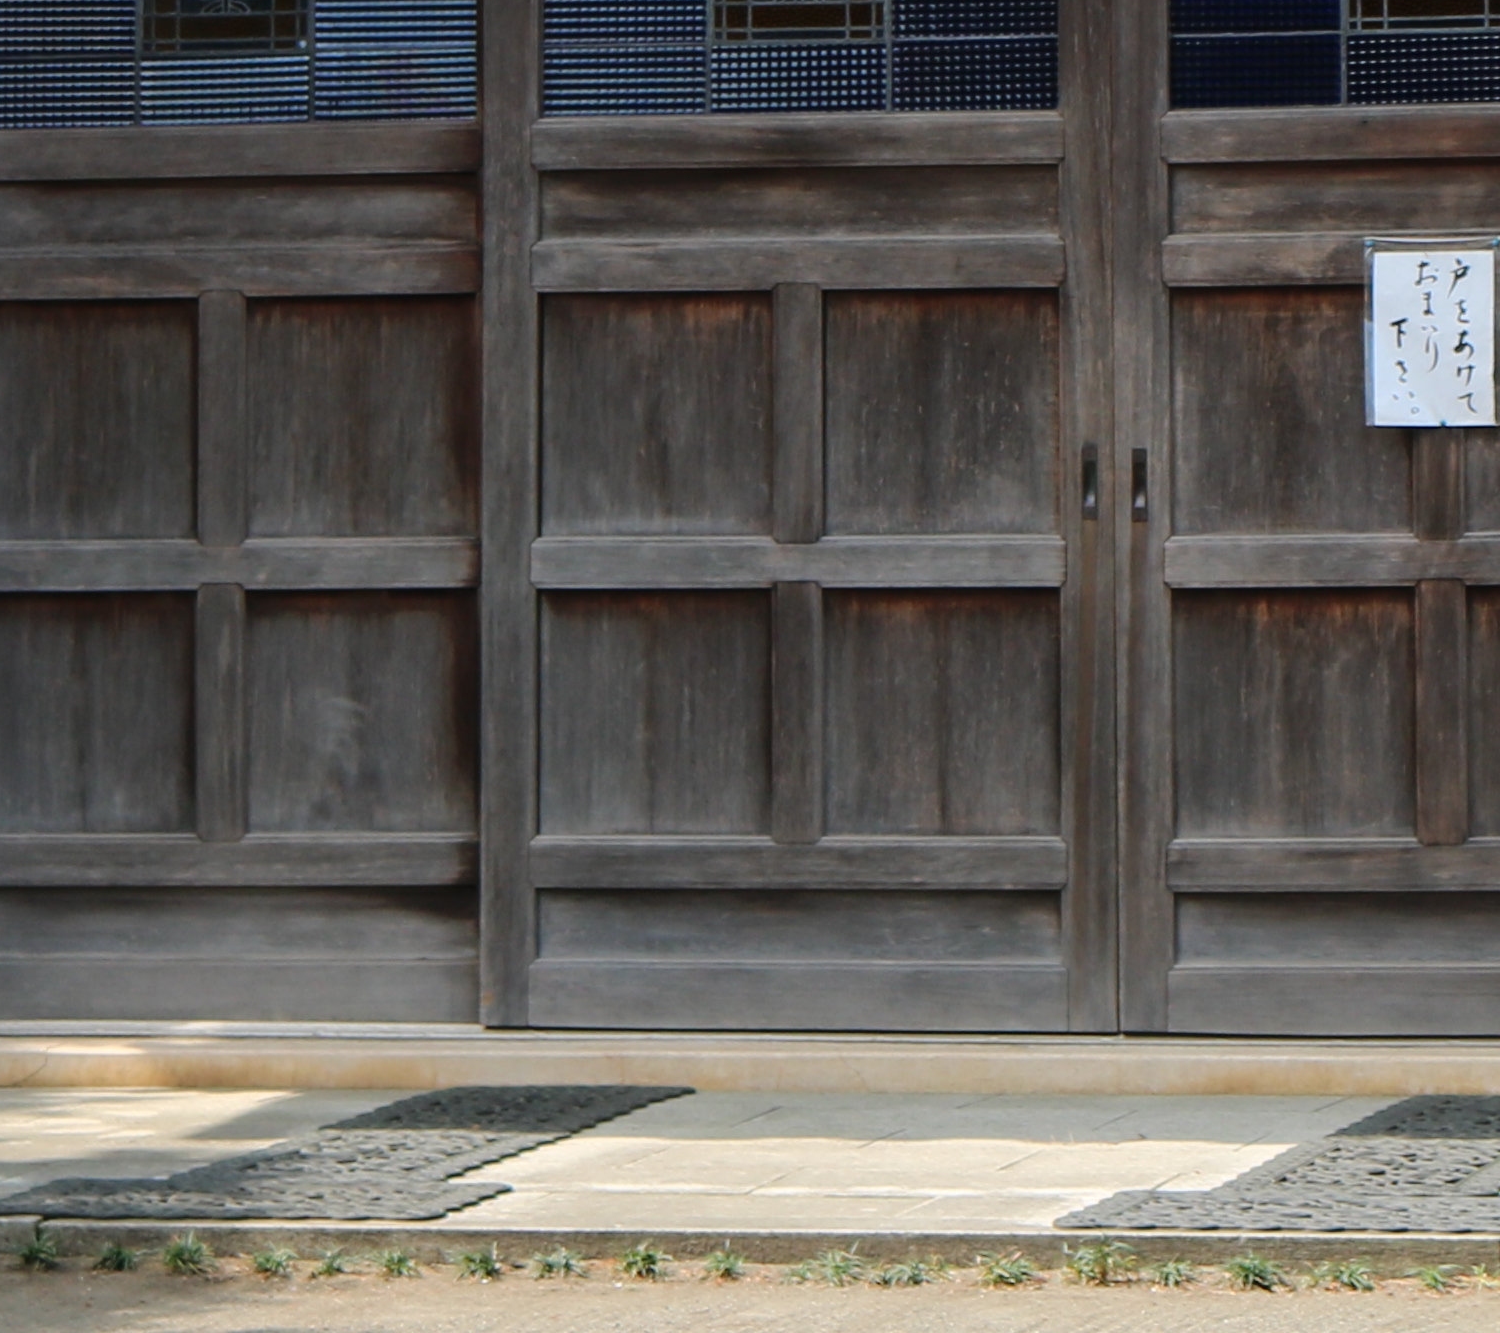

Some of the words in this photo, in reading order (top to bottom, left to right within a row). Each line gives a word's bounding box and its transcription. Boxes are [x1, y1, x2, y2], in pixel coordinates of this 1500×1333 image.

[1414, 260, 1440, 373] おまいり
[1447, 257, 1478, 414] 戸をあけて
